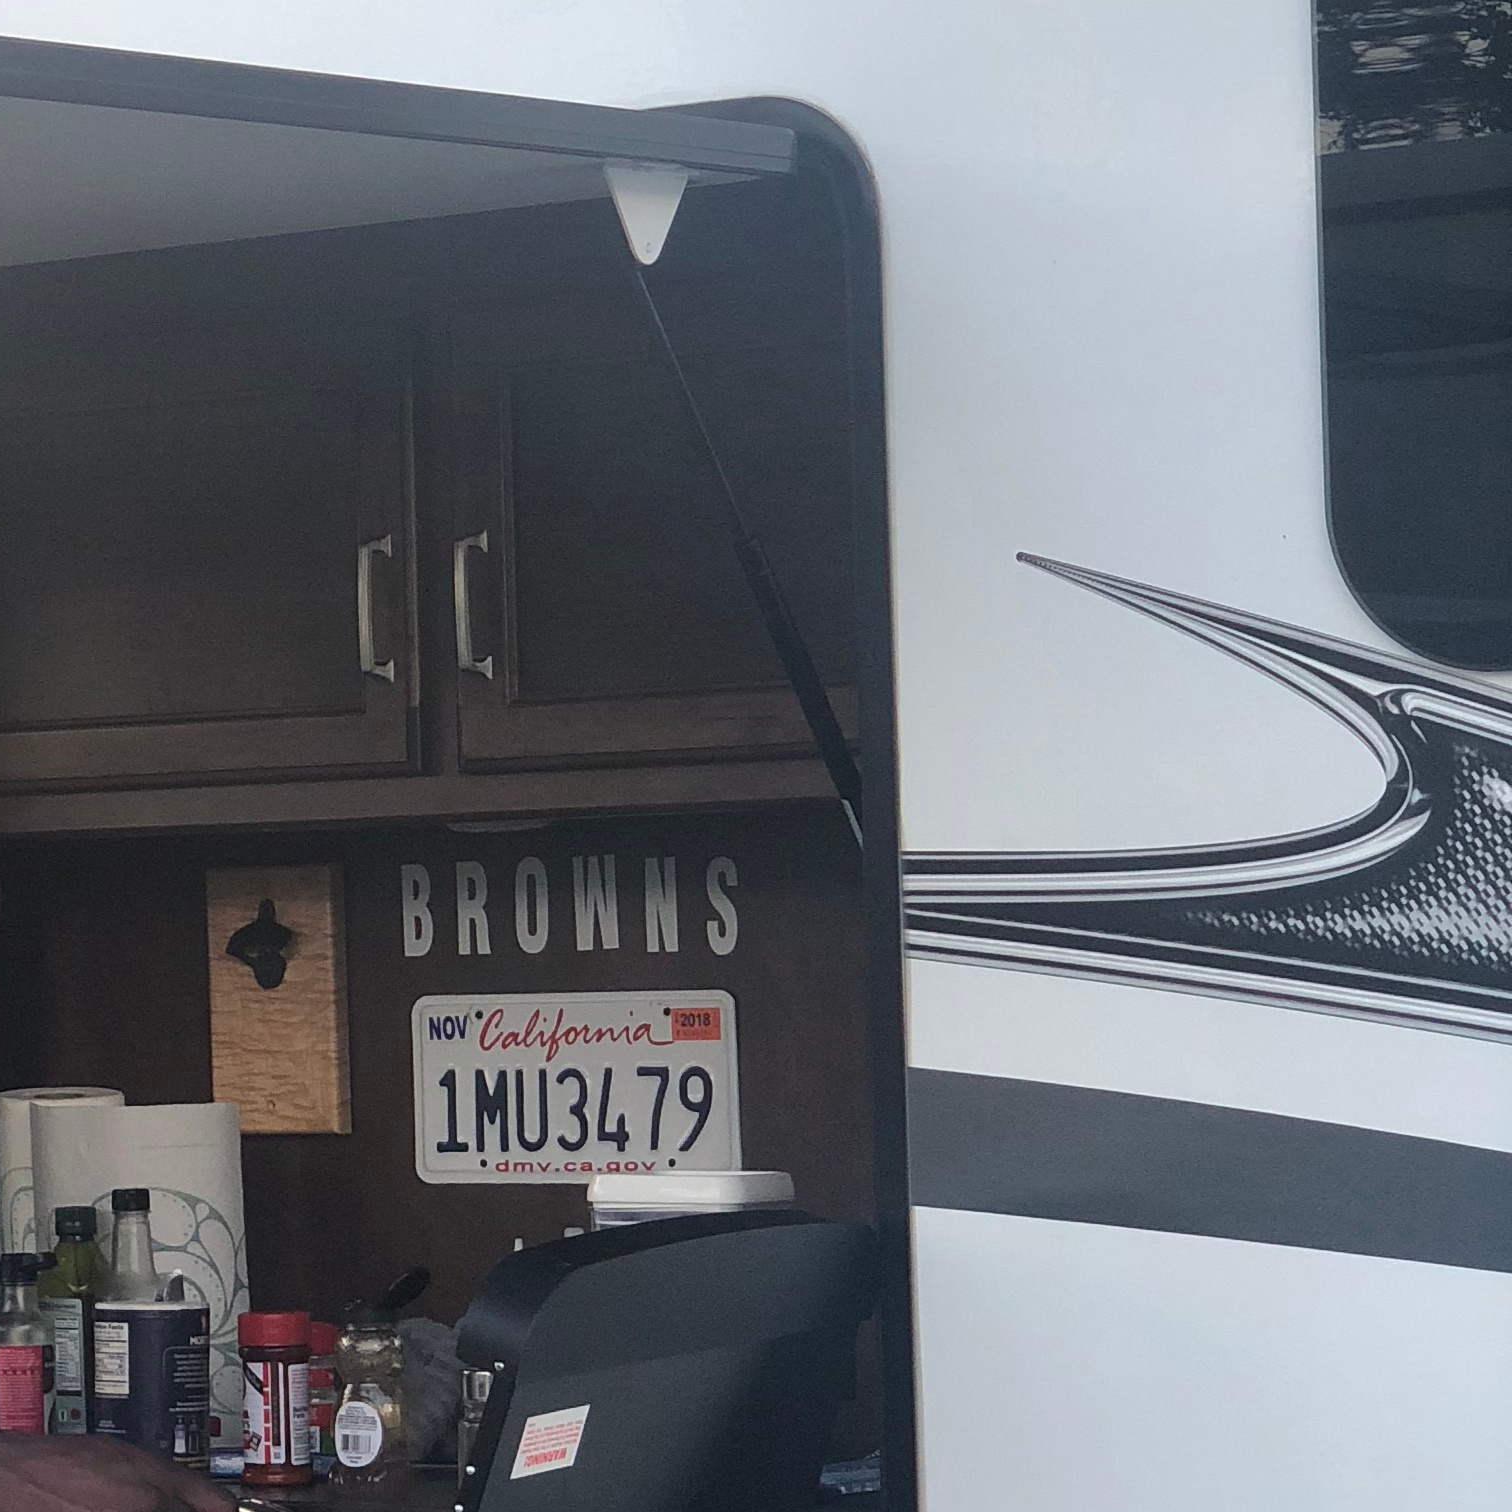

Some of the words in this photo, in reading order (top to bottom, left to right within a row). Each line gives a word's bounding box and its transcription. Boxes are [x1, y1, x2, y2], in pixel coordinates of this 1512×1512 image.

[400, 854, 739, 958] BROWNS
[428, 1015, 468, 1041] NOV
[479, 1008, 674, 1063] California
[680, 1012, 711, 1028] 2018
[435, 1065, 714, 1153] 1MU3479
[494, 1159, 657, 1174] dmv.ca.gov
